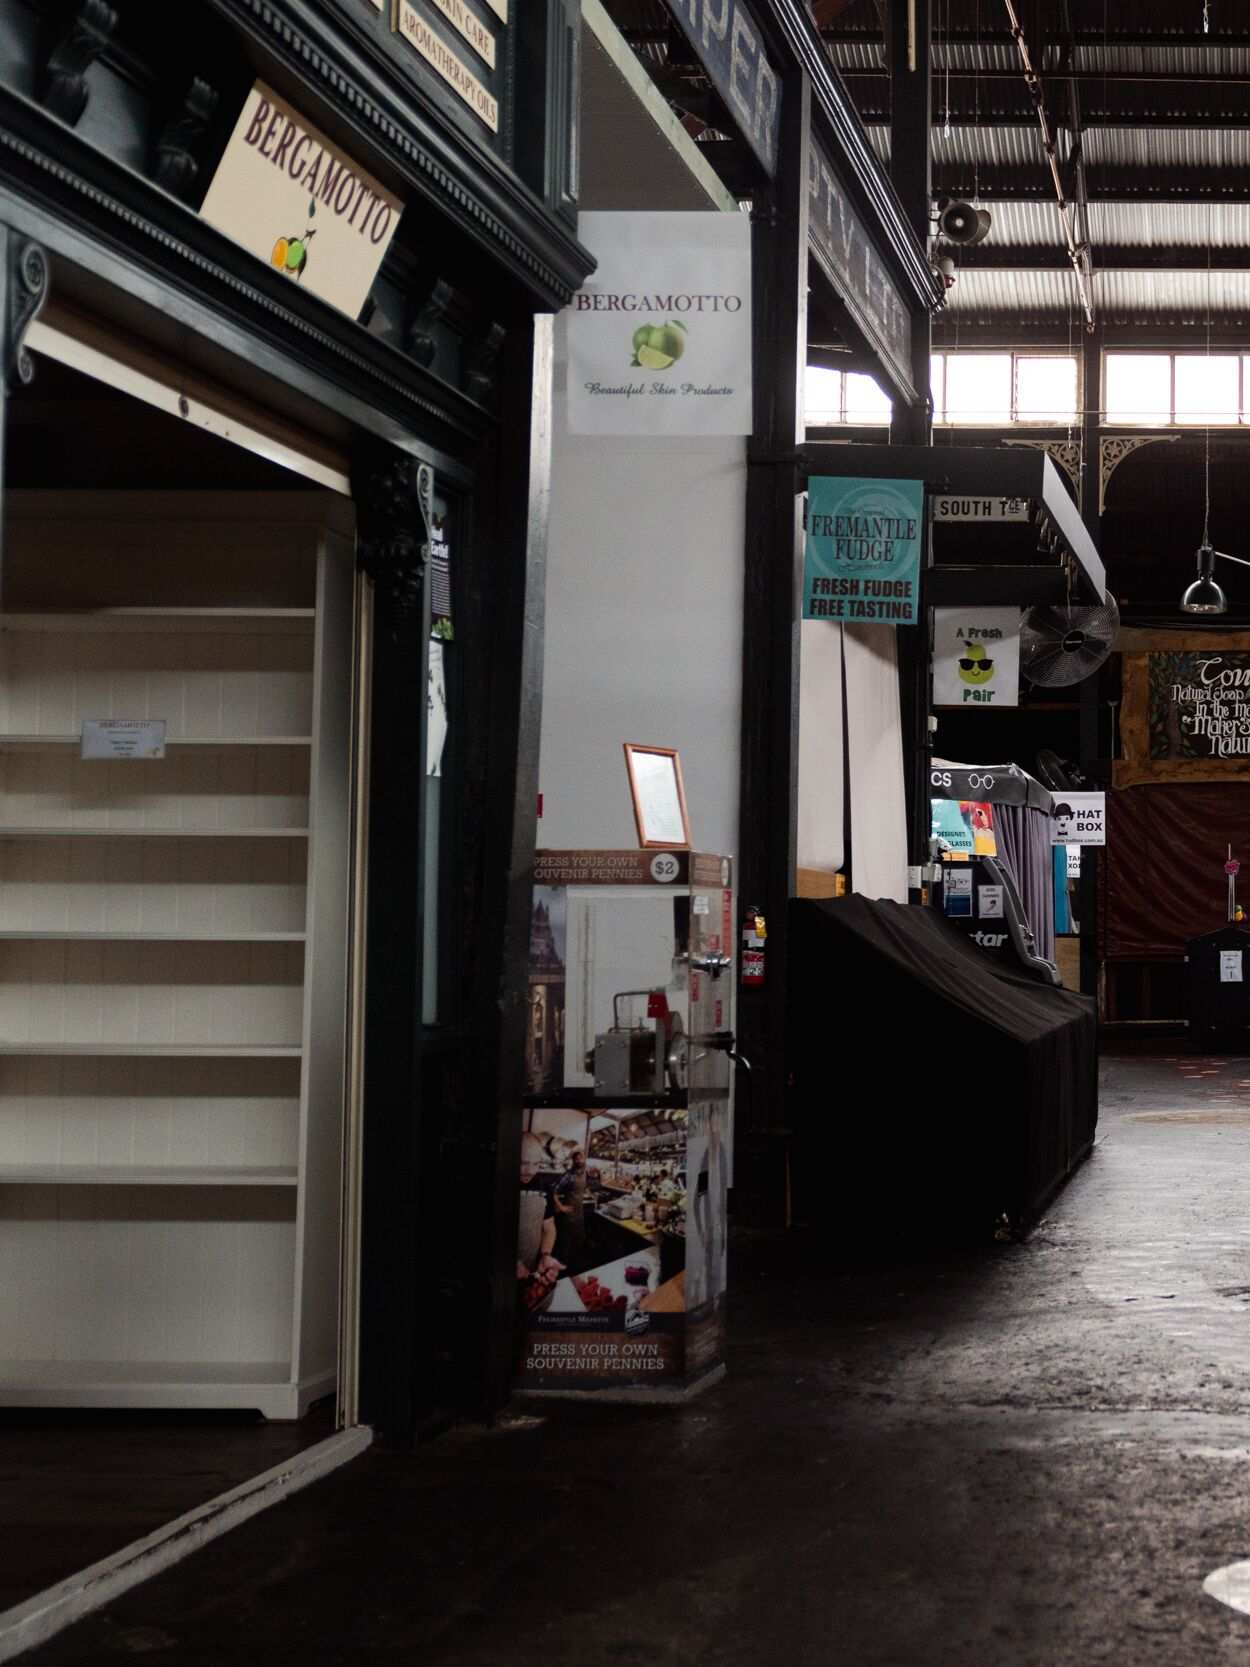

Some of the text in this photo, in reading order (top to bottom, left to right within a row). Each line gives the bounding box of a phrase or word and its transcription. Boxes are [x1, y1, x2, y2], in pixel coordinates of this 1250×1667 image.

[244, 99, 391, 245] BERGAMOTTO
[576, 293, 742, 313] BERGAMOTTO
[584, 382, 734, 399] Beautiful Skin Products
[940, 500, 992, 516] SOUTH
[811, 514, 917, 541] FREMANTLE
[834, 538, 895, 562] FUDGE
[812, 577, 913, 598] FRESH FUDGE
[809, 598, 913, 620] FREE TASTING
[956, 627, 1003, 639] A Fresh
[963, 689, 996, 703] Pair
[1076, 809, 1102, 819] HAT
[1076, 821, 1103, 832] BOX
[534, 856, 675, 875] PRESS YOUR OWN $2
[533, 868, 644, 880] OUVENIR PENNIES
[532, 1343, 659, 1356] PRESS YOUR OWN
[526, 1358, 665, 1370] SOUVENIR PENNIES
